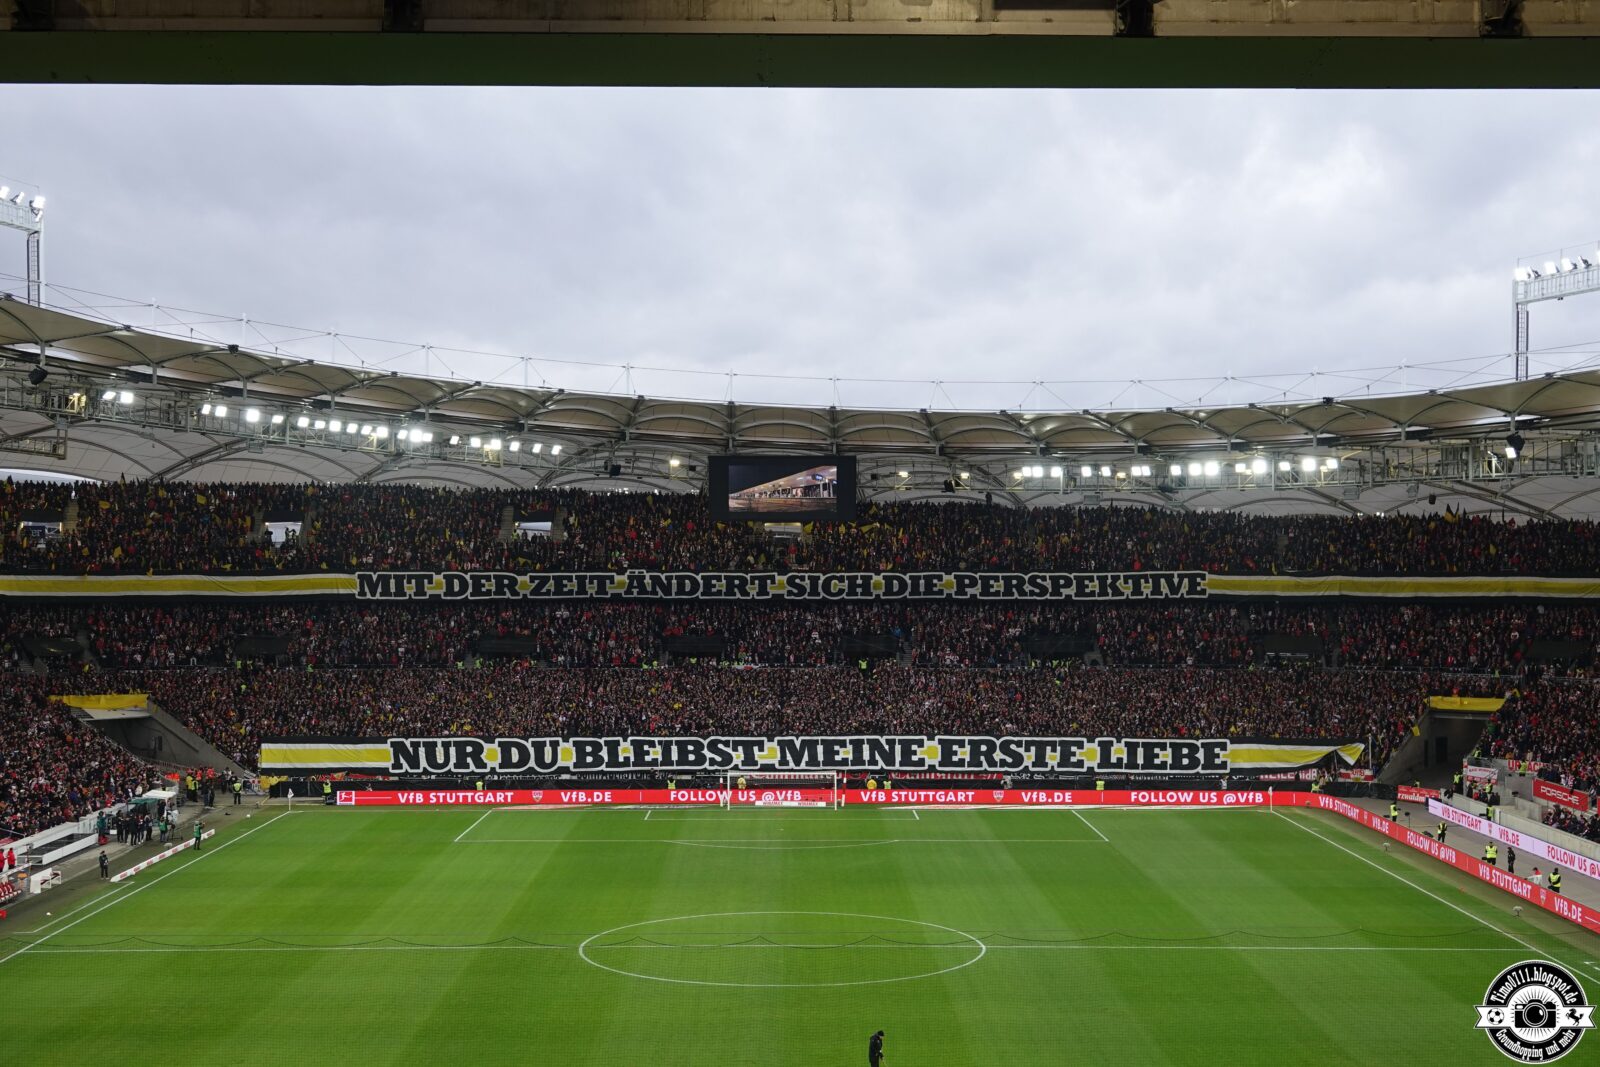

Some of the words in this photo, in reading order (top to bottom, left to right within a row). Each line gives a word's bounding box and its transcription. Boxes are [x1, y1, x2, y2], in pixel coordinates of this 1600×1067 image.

[356, 572, 435, 599] MIT
[441, 572, 523, 599] DER
[527, 573, 617, 599] ZEIT
[621, 569, 778, 599] ÄNDERT
[784, 572, 875, 599] SICH
[880, 572, 945, 599] DIE
[953, 571, 1207, 600] PERSPEKTIVE
[388, 738, 487, 773] NUR
[496, 738, 562, 772] DU
[569, 737, 768, 772] BLEIBST
[776, 736, 928, 770] MEINE
[935, 736, 1087, 771] ERSTE
[1094, 738, 1230, 773] LIEBE
[398, 792, 423, 803] VfB
[430, 792, 514, 803] STUTTGART
[561, 791, 612, 802] VfB.DE
[671, 790, 732, 802] FOLLOW
[739, 790, 757, 802] US
[762, 790, 802, 802] @VfB
[861, 791, 886, 802] VfB
[892, 791, 975, 802] STUTTGART
[1021, 791, 1072, 802] VfB.DE
[1131, 792, 1193, 803] FOLLOW
[1200, 792, 1217, 803] US
[1223, 792, 1264, 804] @VfB
[1540, 786, 1580, 806] PORSCHE
[1319, 796, 1333, 809] VfB
[1334, 799, 1360, 820] STUTTGART
[1372, 815, 1389, 834] VfB.DE
[1441, 805, 1451, 819] VfB
[1451, 810, 1481, 832] STUTTGART
[1499, 827, 1520, 847] VfB.DE
[1407, 831, 1430, 851] FOLLOW
[1431, 842, 1439, 856] US
[1440, 846, 1456, 864] @VfB
[1547, 845, 1576, 868] FOLLOW
[1578, 857, 1587, 872] US
[1479, 863, 1490, 880] VfB
[1491, 869, 1531, 899] STUTTGART
[1554, 896, 1582, 922] VfB.DE
